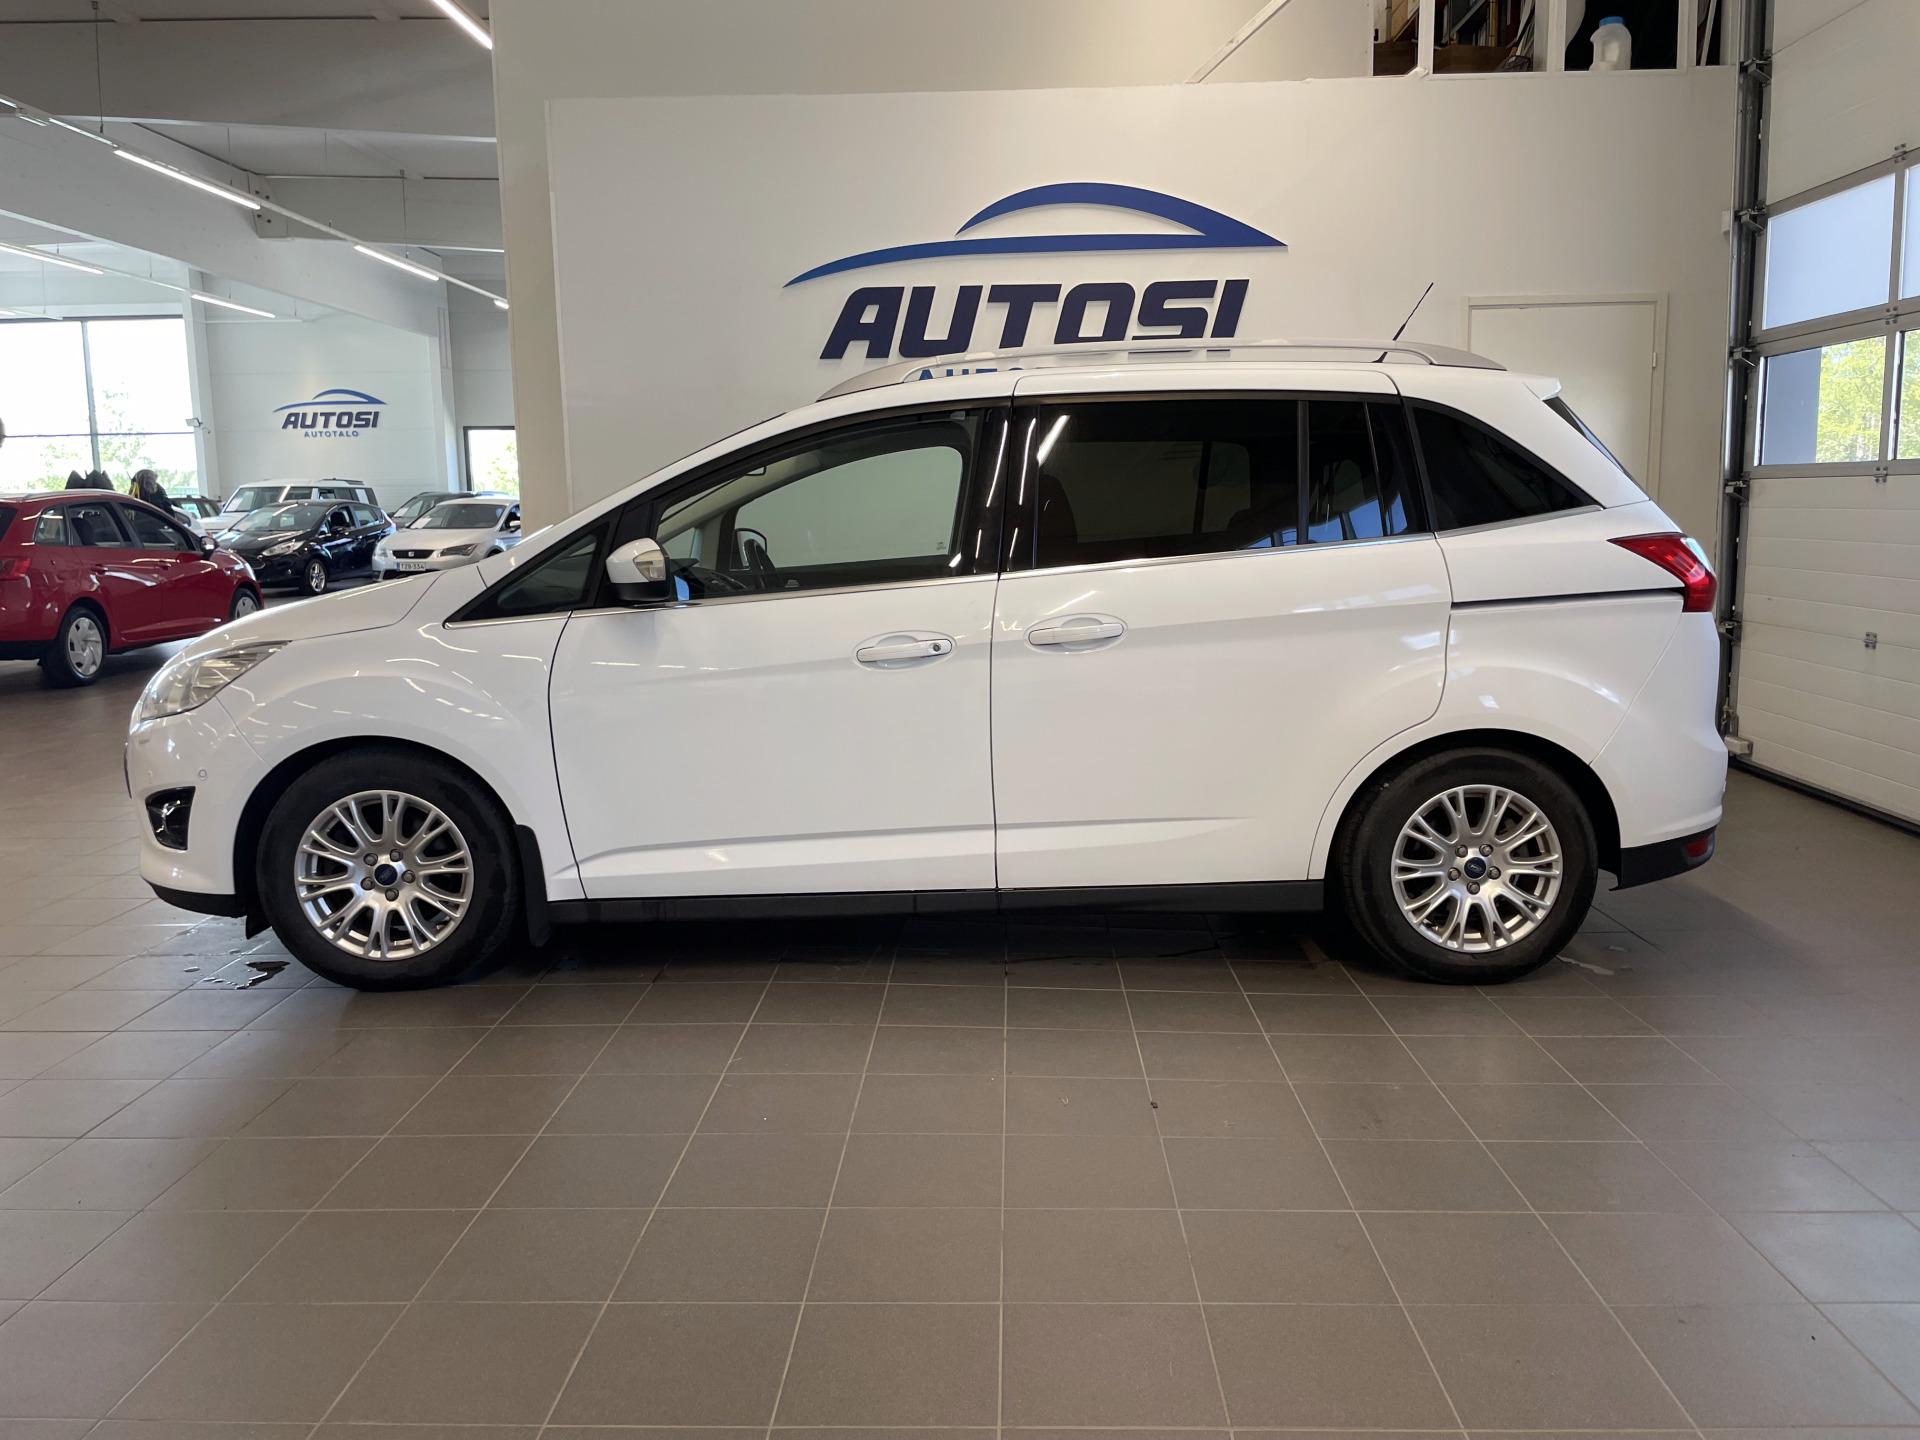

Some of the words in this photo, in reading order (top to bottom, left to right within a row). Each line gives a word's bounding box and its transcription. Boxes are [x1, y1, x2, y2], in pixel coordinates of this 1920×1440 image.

[820, 279, 1250, 360] AUTOSI
[281, 411, 380, 430] AUTOSI
[304, 430, 359, 438] AUTOTALO
